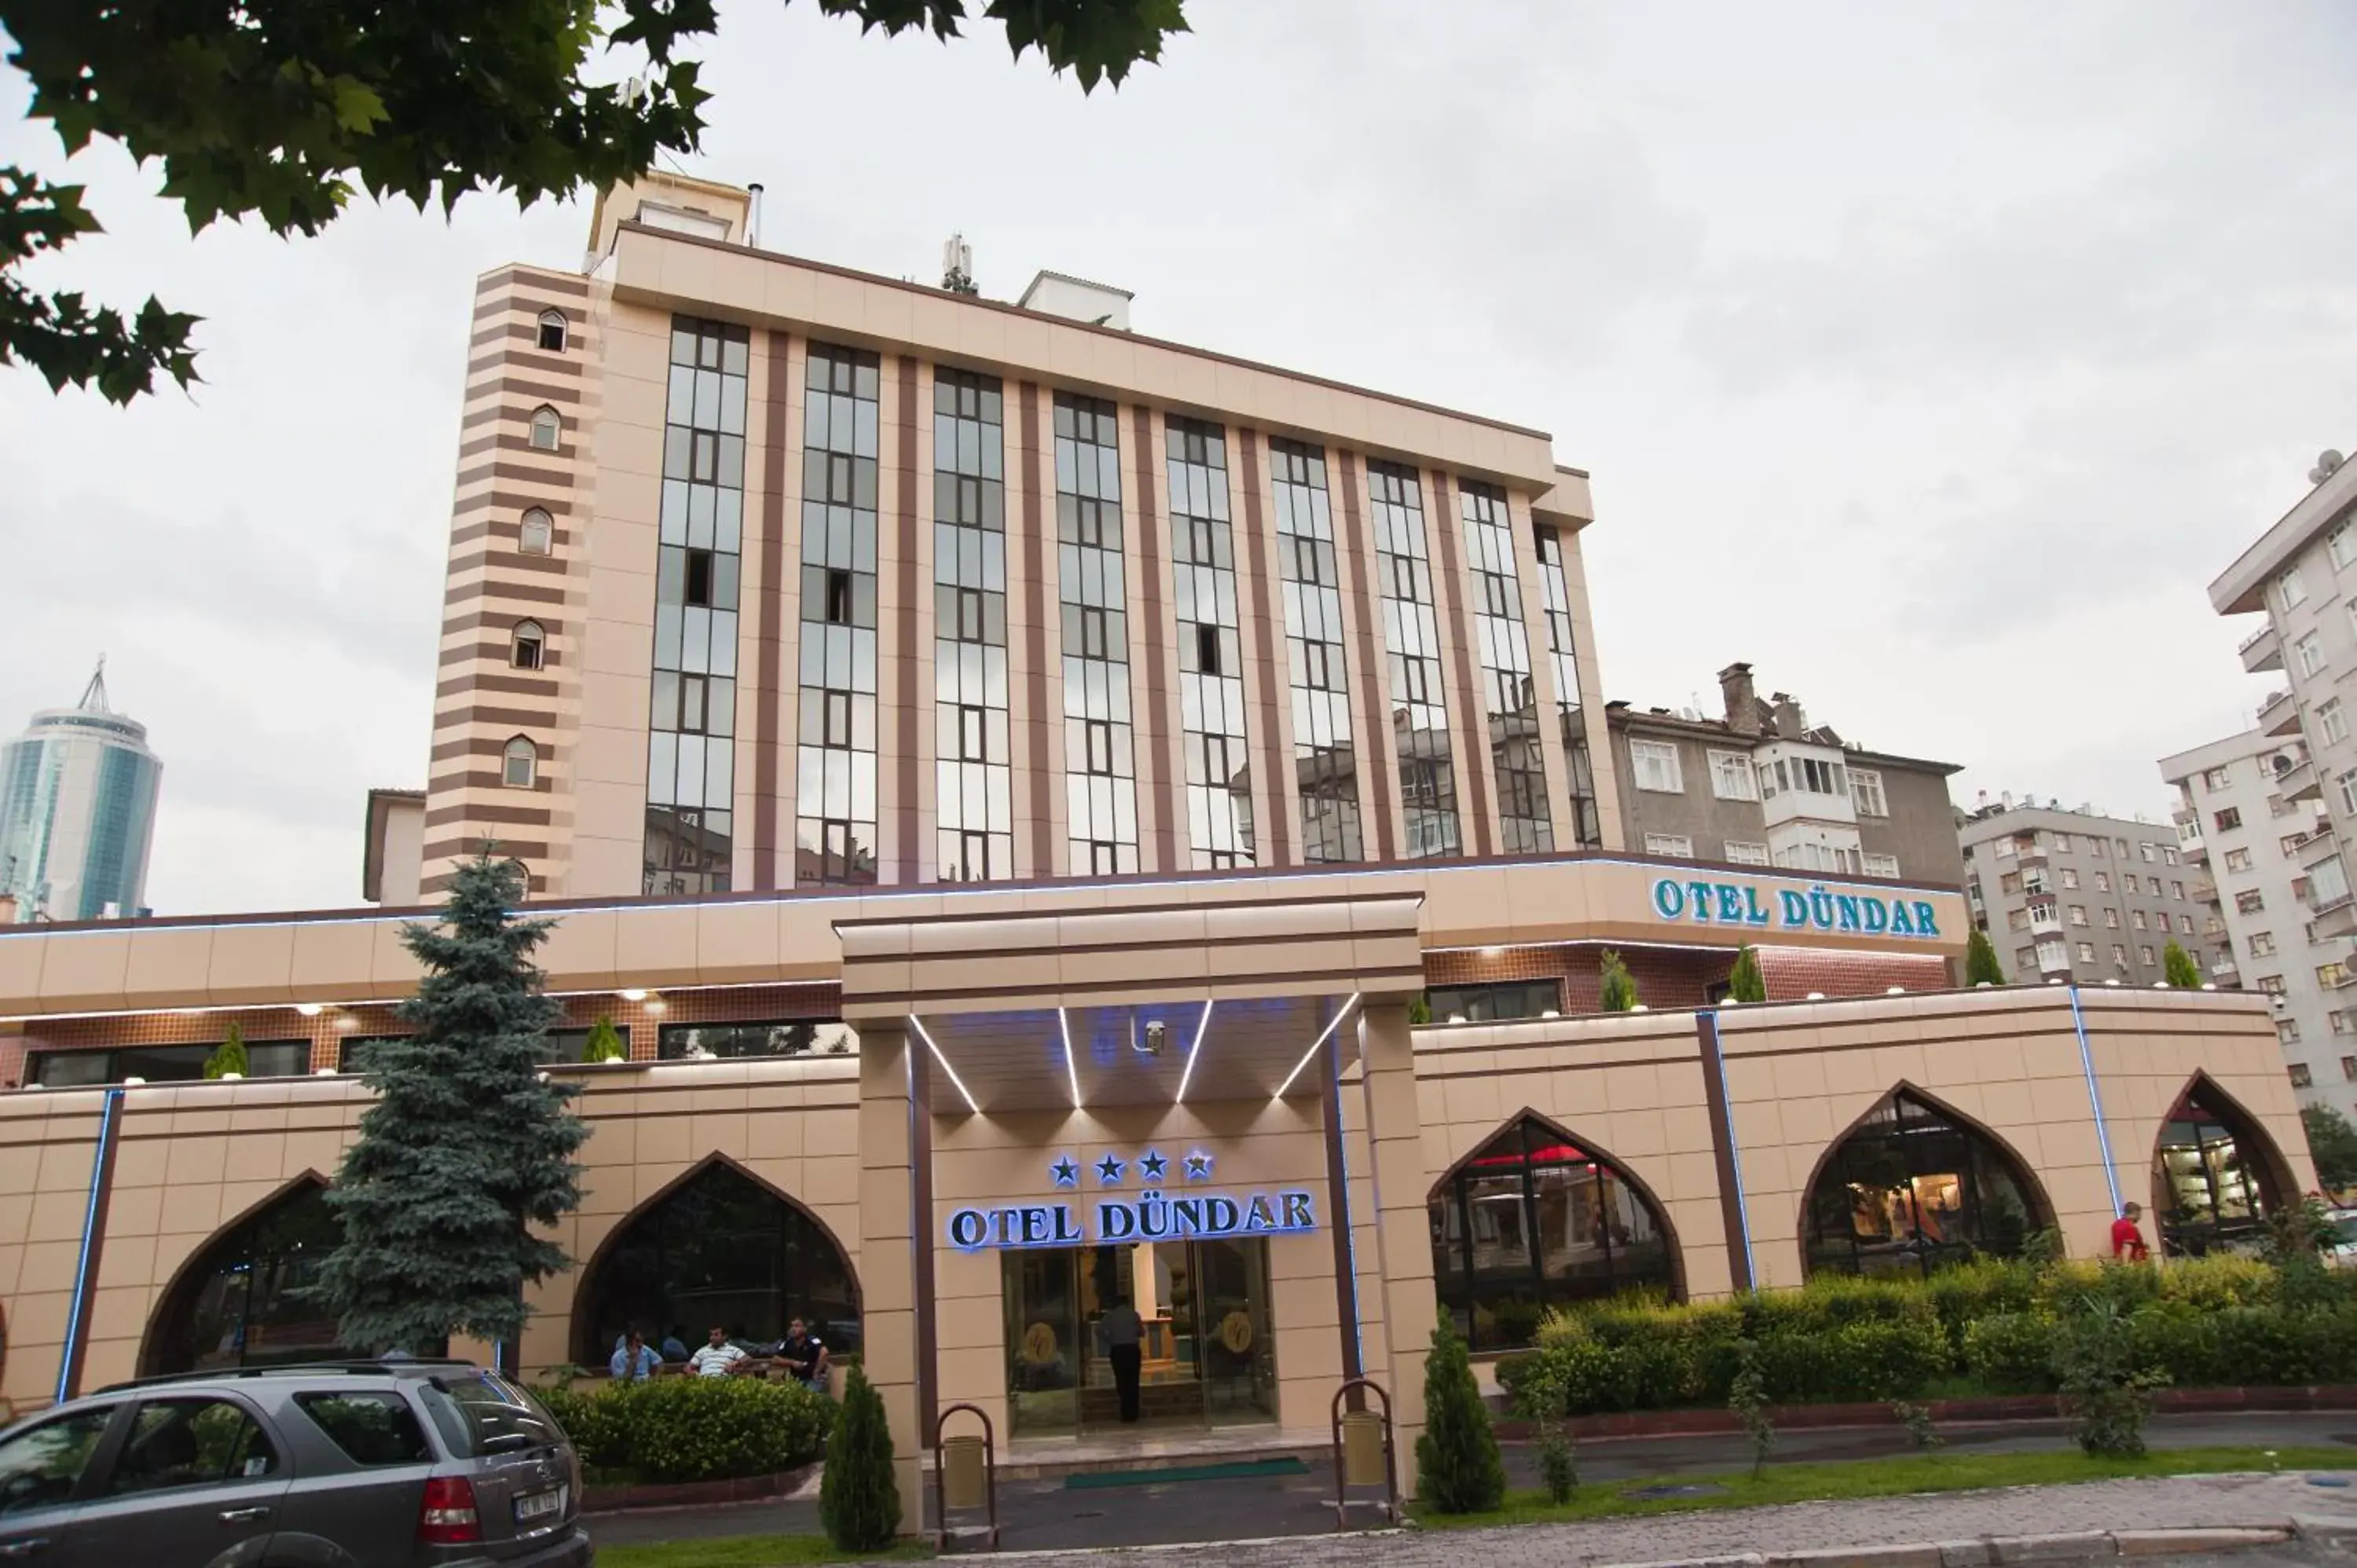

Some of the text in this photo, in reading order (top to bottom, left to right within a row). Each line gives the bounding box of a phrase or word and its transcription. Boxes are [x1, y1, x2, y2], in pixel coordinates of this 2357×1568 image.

[1653, 879, 1940, 936] OTEL DÜNDAR
[951, 1190, 1314, 1246] OTEL DÜNDAR
